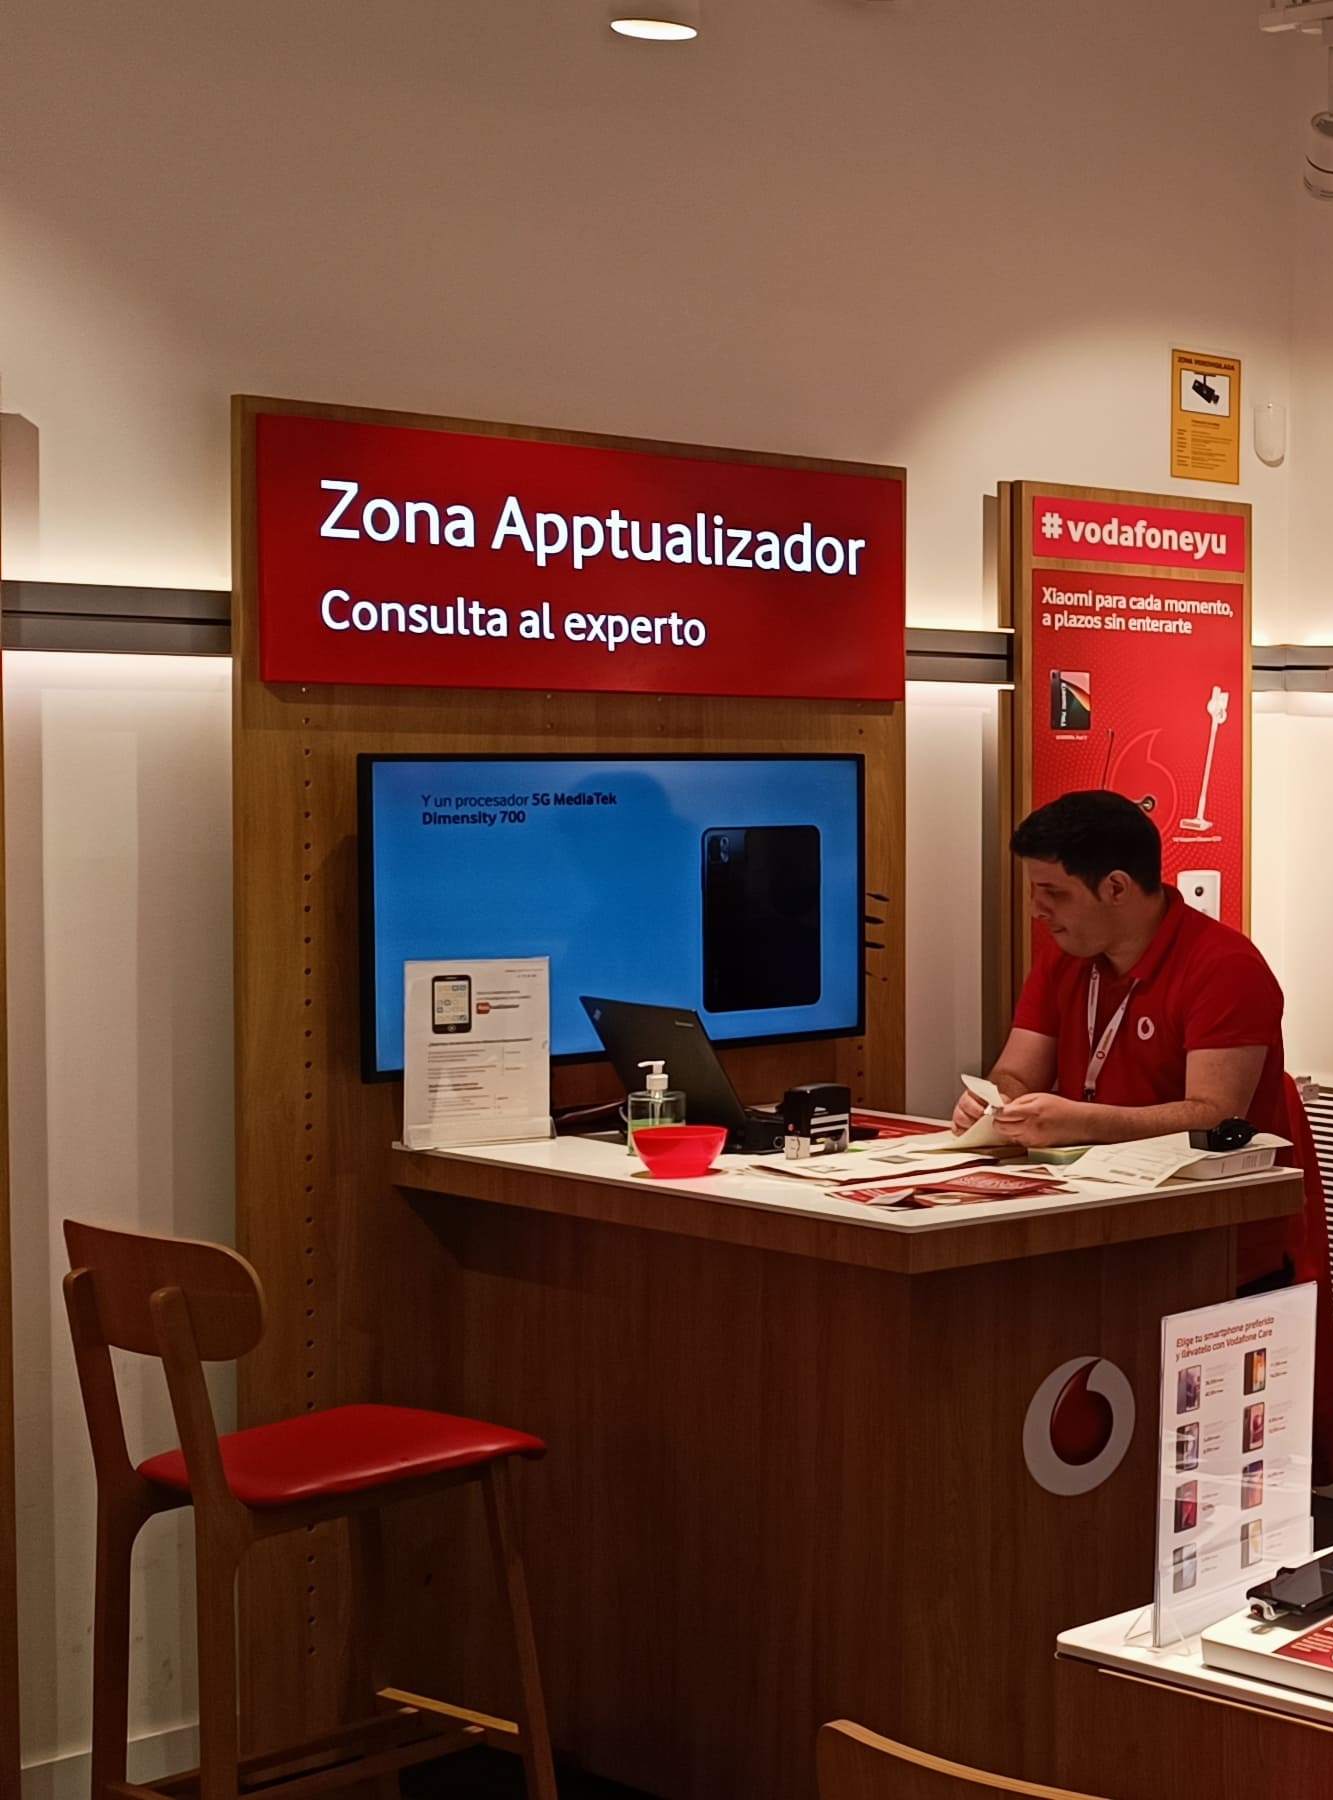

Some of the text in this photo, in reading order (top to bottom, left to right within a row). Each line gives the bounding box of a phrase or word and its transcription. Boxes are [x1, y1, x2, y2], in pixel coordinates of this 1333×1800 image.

[319, 479, 867, 576] Zona Apptualizador
[1042, 587, 1234, 617] Xiaomi para cada momento,
[320, 588, 707, 652] Consulta al experto
[1042, 610, 1193, 634] a plazos sin enterarte
[421, 791, 617, 810] Y un procesador 5G MediaTek
[422, 810, 526, 827] Dimensity 700
[1195, 1335, 1203, 1344] tu
[1204, 1324, 1244, 1341] smartphone
[1245, 1316, 1275, 1332] preferido
[1212, 1341, 1225, 1351] con
[1226, 1332, 1257, 1347] Vodafone
[1258, 1329, 1273, 1339] Care
